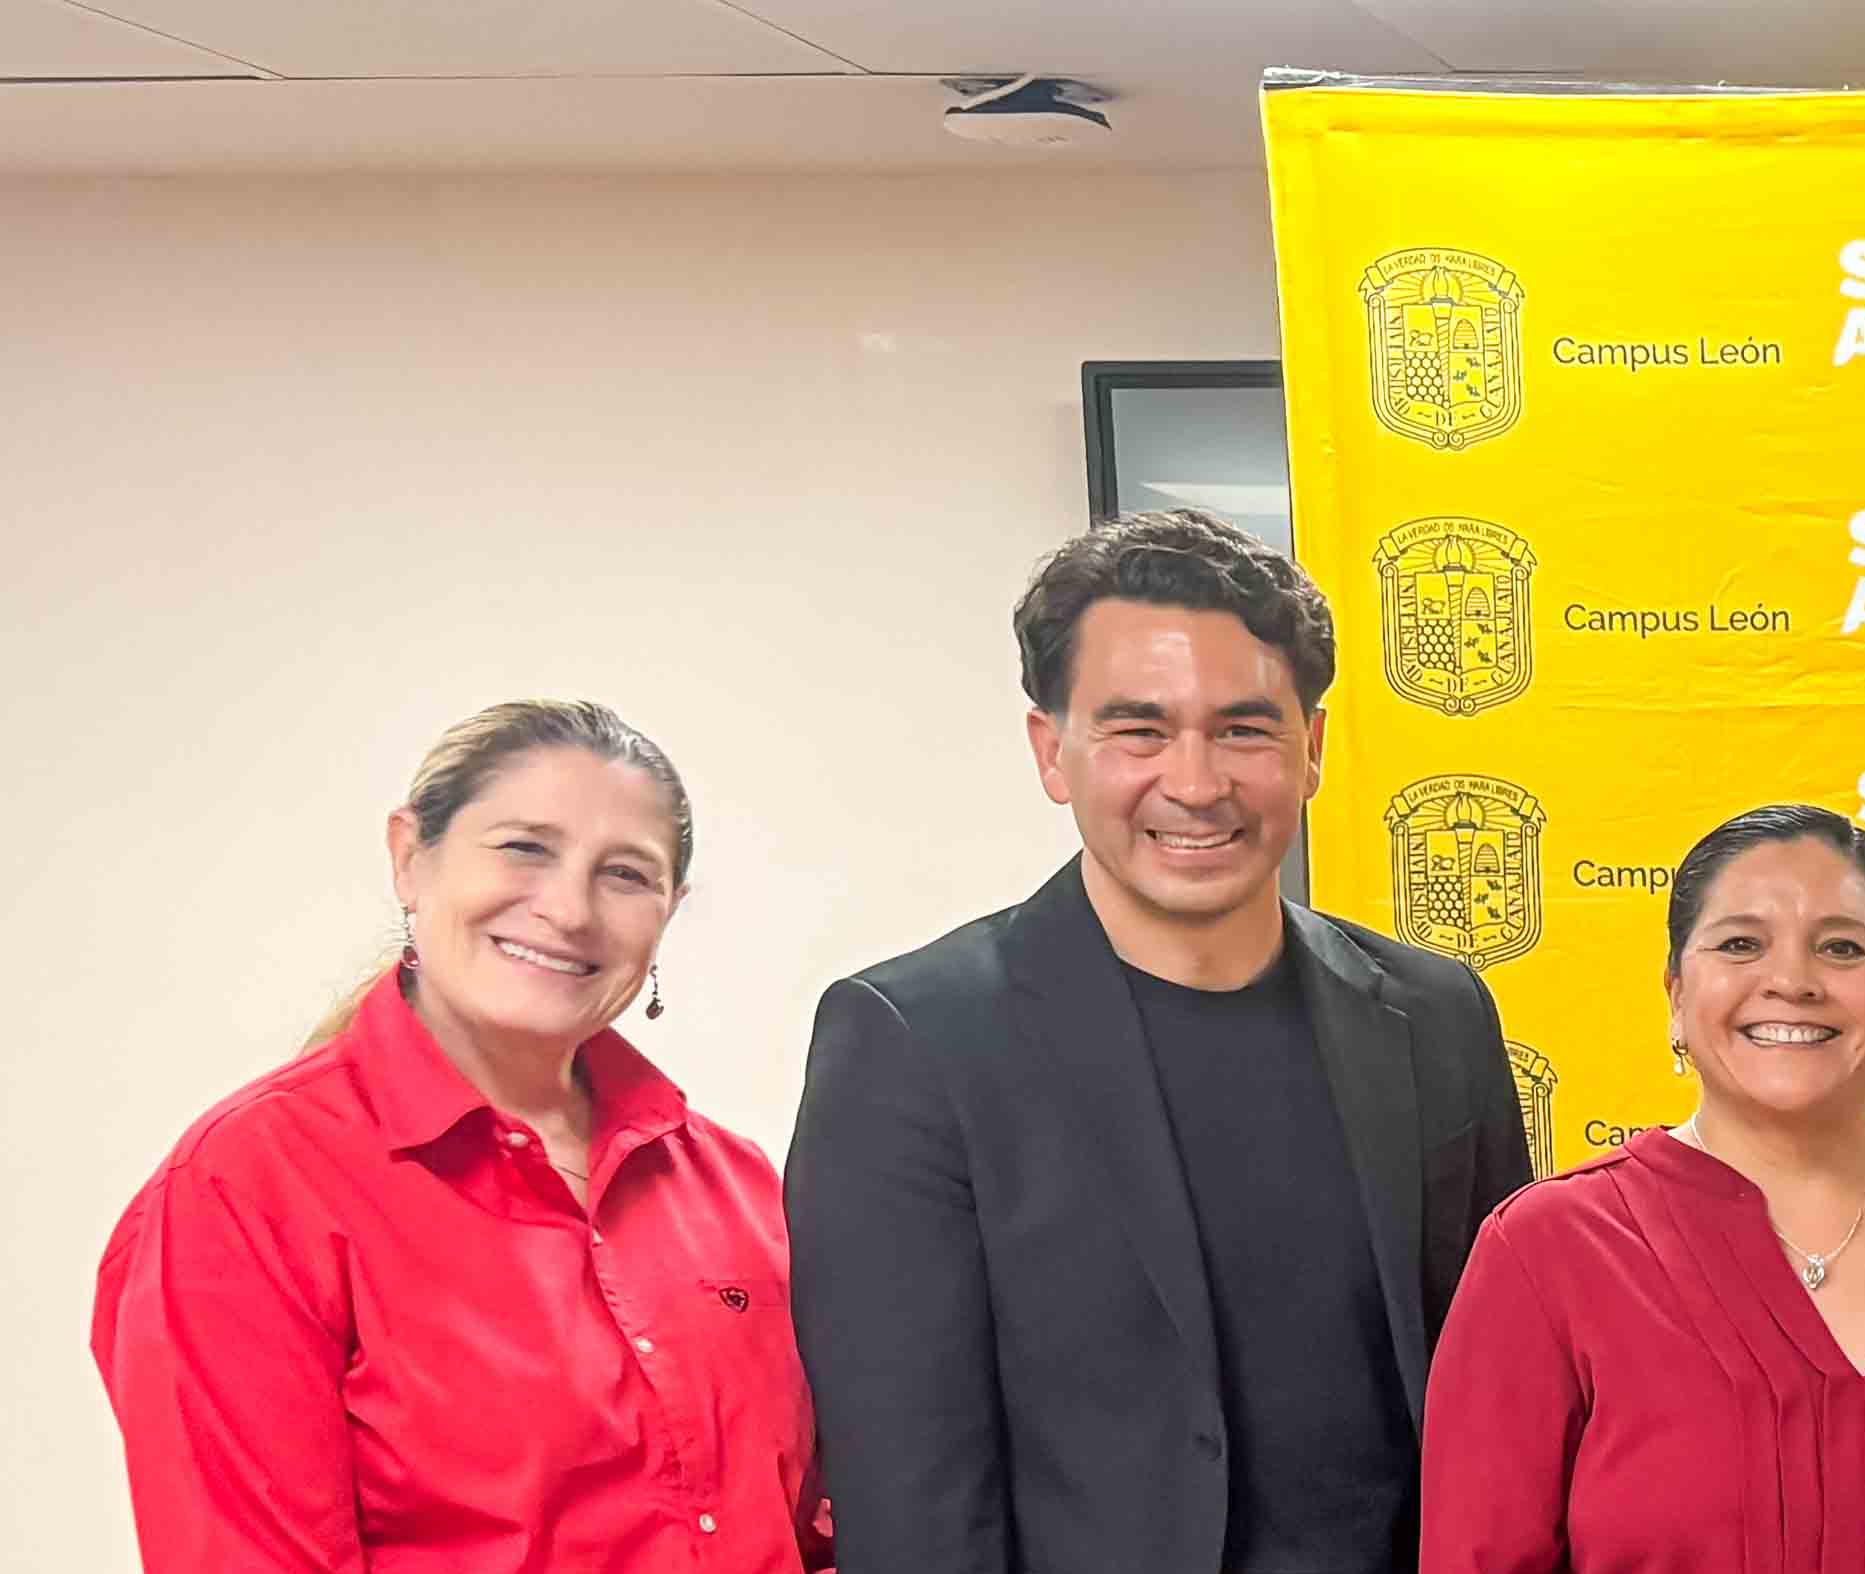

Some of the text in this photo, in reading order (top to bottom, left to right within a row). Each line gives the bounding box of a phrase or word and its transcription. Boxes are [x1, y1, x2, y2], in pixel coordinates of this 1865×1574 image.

[1551, 335, 1782, 374] Campus León
[1563, 602, 1791, 641] Campus León
[1572, 859, 1676, 896] Camp
